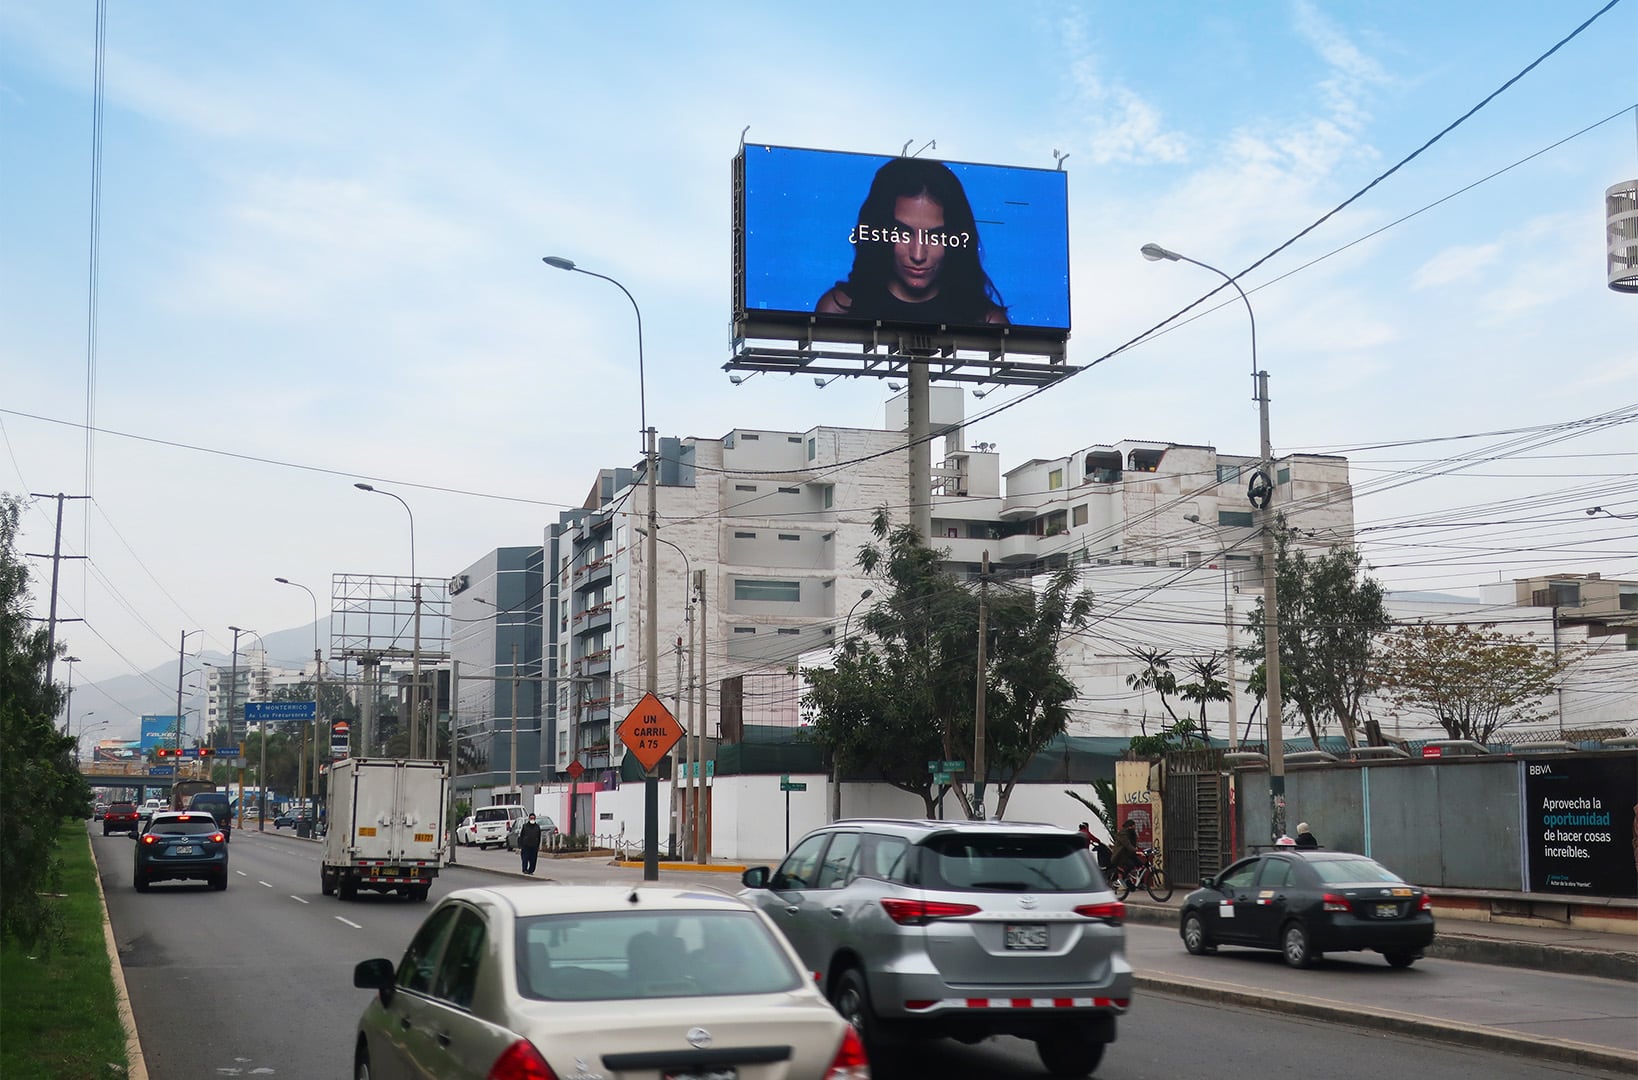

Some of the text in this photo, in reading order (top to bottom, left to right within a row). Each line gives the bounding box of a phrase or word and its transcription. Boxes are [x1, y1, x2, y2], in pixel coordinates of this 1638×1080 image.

[848, 225, 970, 248] ¿Estás listo?
[643, 715, 657, 724] UN
[633, 727, 668, 737] CARRIL
[639, 740, 659, 749] A 75
[1529, 764, 1552, 775] BBVA
[1542, 796, 1602, 812] Aprovecha la
[1543, 812, 1610, 828] oportunidad
[1543, 829, 1612, 843] de hacer cosas
[1544, 844, 1591, 859] increíbles.
